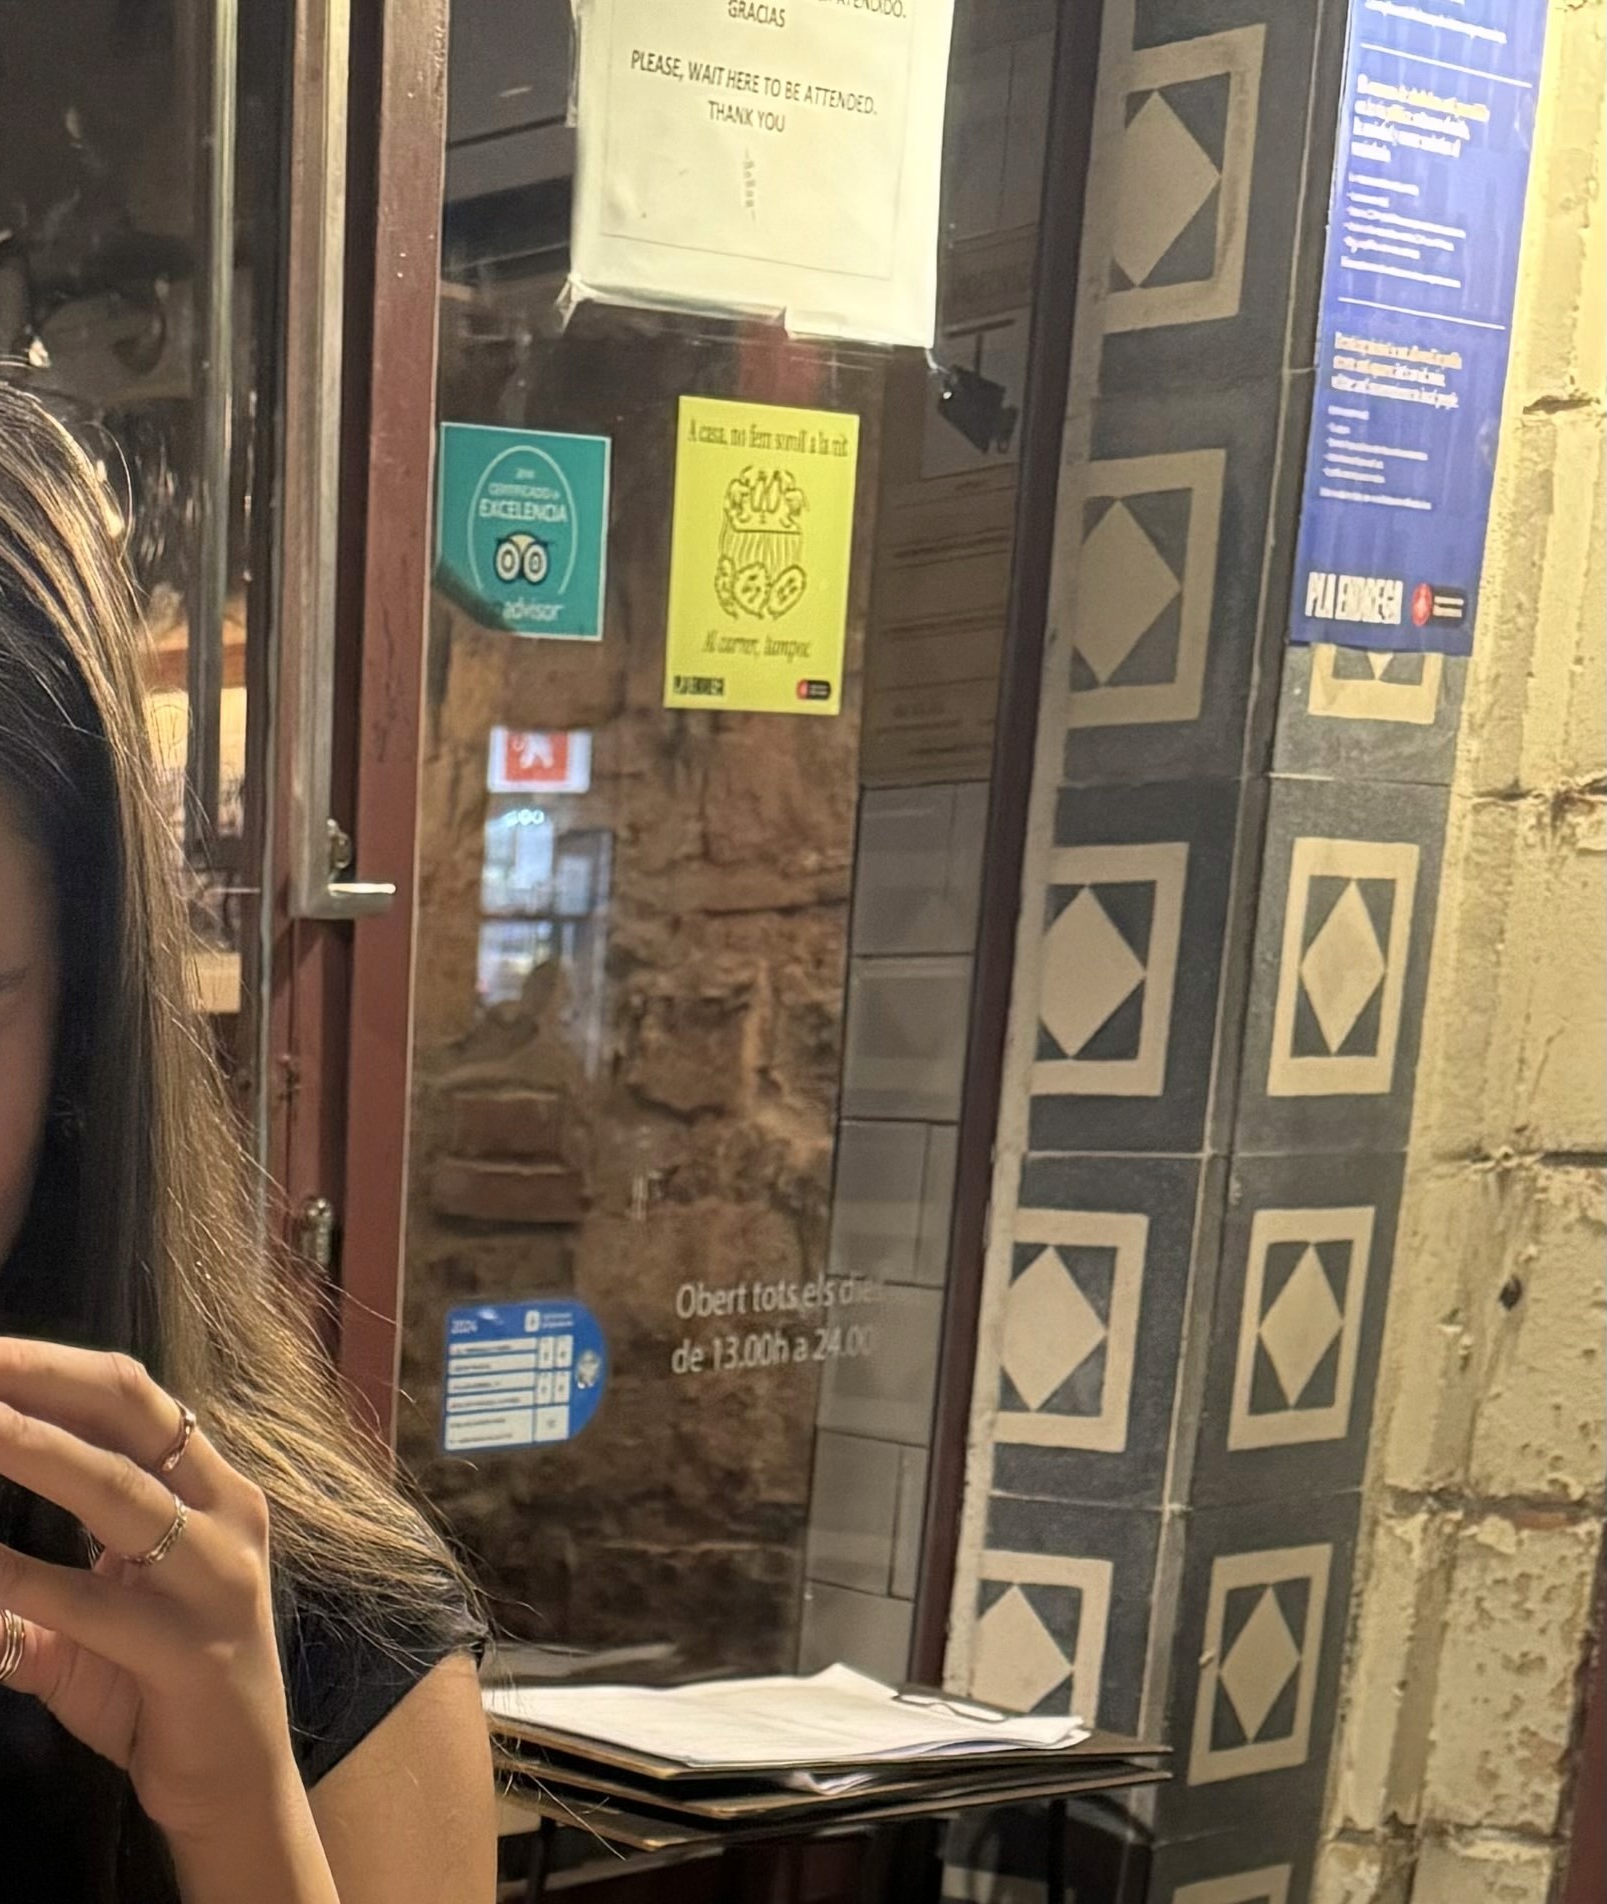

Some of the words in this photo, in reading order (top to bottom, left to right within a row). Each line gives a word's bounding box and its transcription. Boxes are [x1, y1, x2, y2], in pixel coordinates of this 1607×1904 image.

[728, 0, 786, 28] GRACIAS
[630, 49, 684, 82] PLEASE,
[688, 61, 725, 87] WAIT
[725, 70, 760, 94] HERE
[764, 76, 782, 98] TO
[785, 80, 801, 102] BE
[804, 84, 878, 115] ATTENDED.
[708, 100, 754, 127] THANK
[757, 109, 786, 133] YOU
[479, 498, 568, 522] EXCELENCIA
[676, 1282, 747, 1320] Obert
[752, 1278, 798, 1313] tots
[802, 1270, 835, 1308] els
[671, 1337, 704, 1375] de
[712, 1330, 790, 1371] 13.00h
[794, 1335, 810, 1363] a
